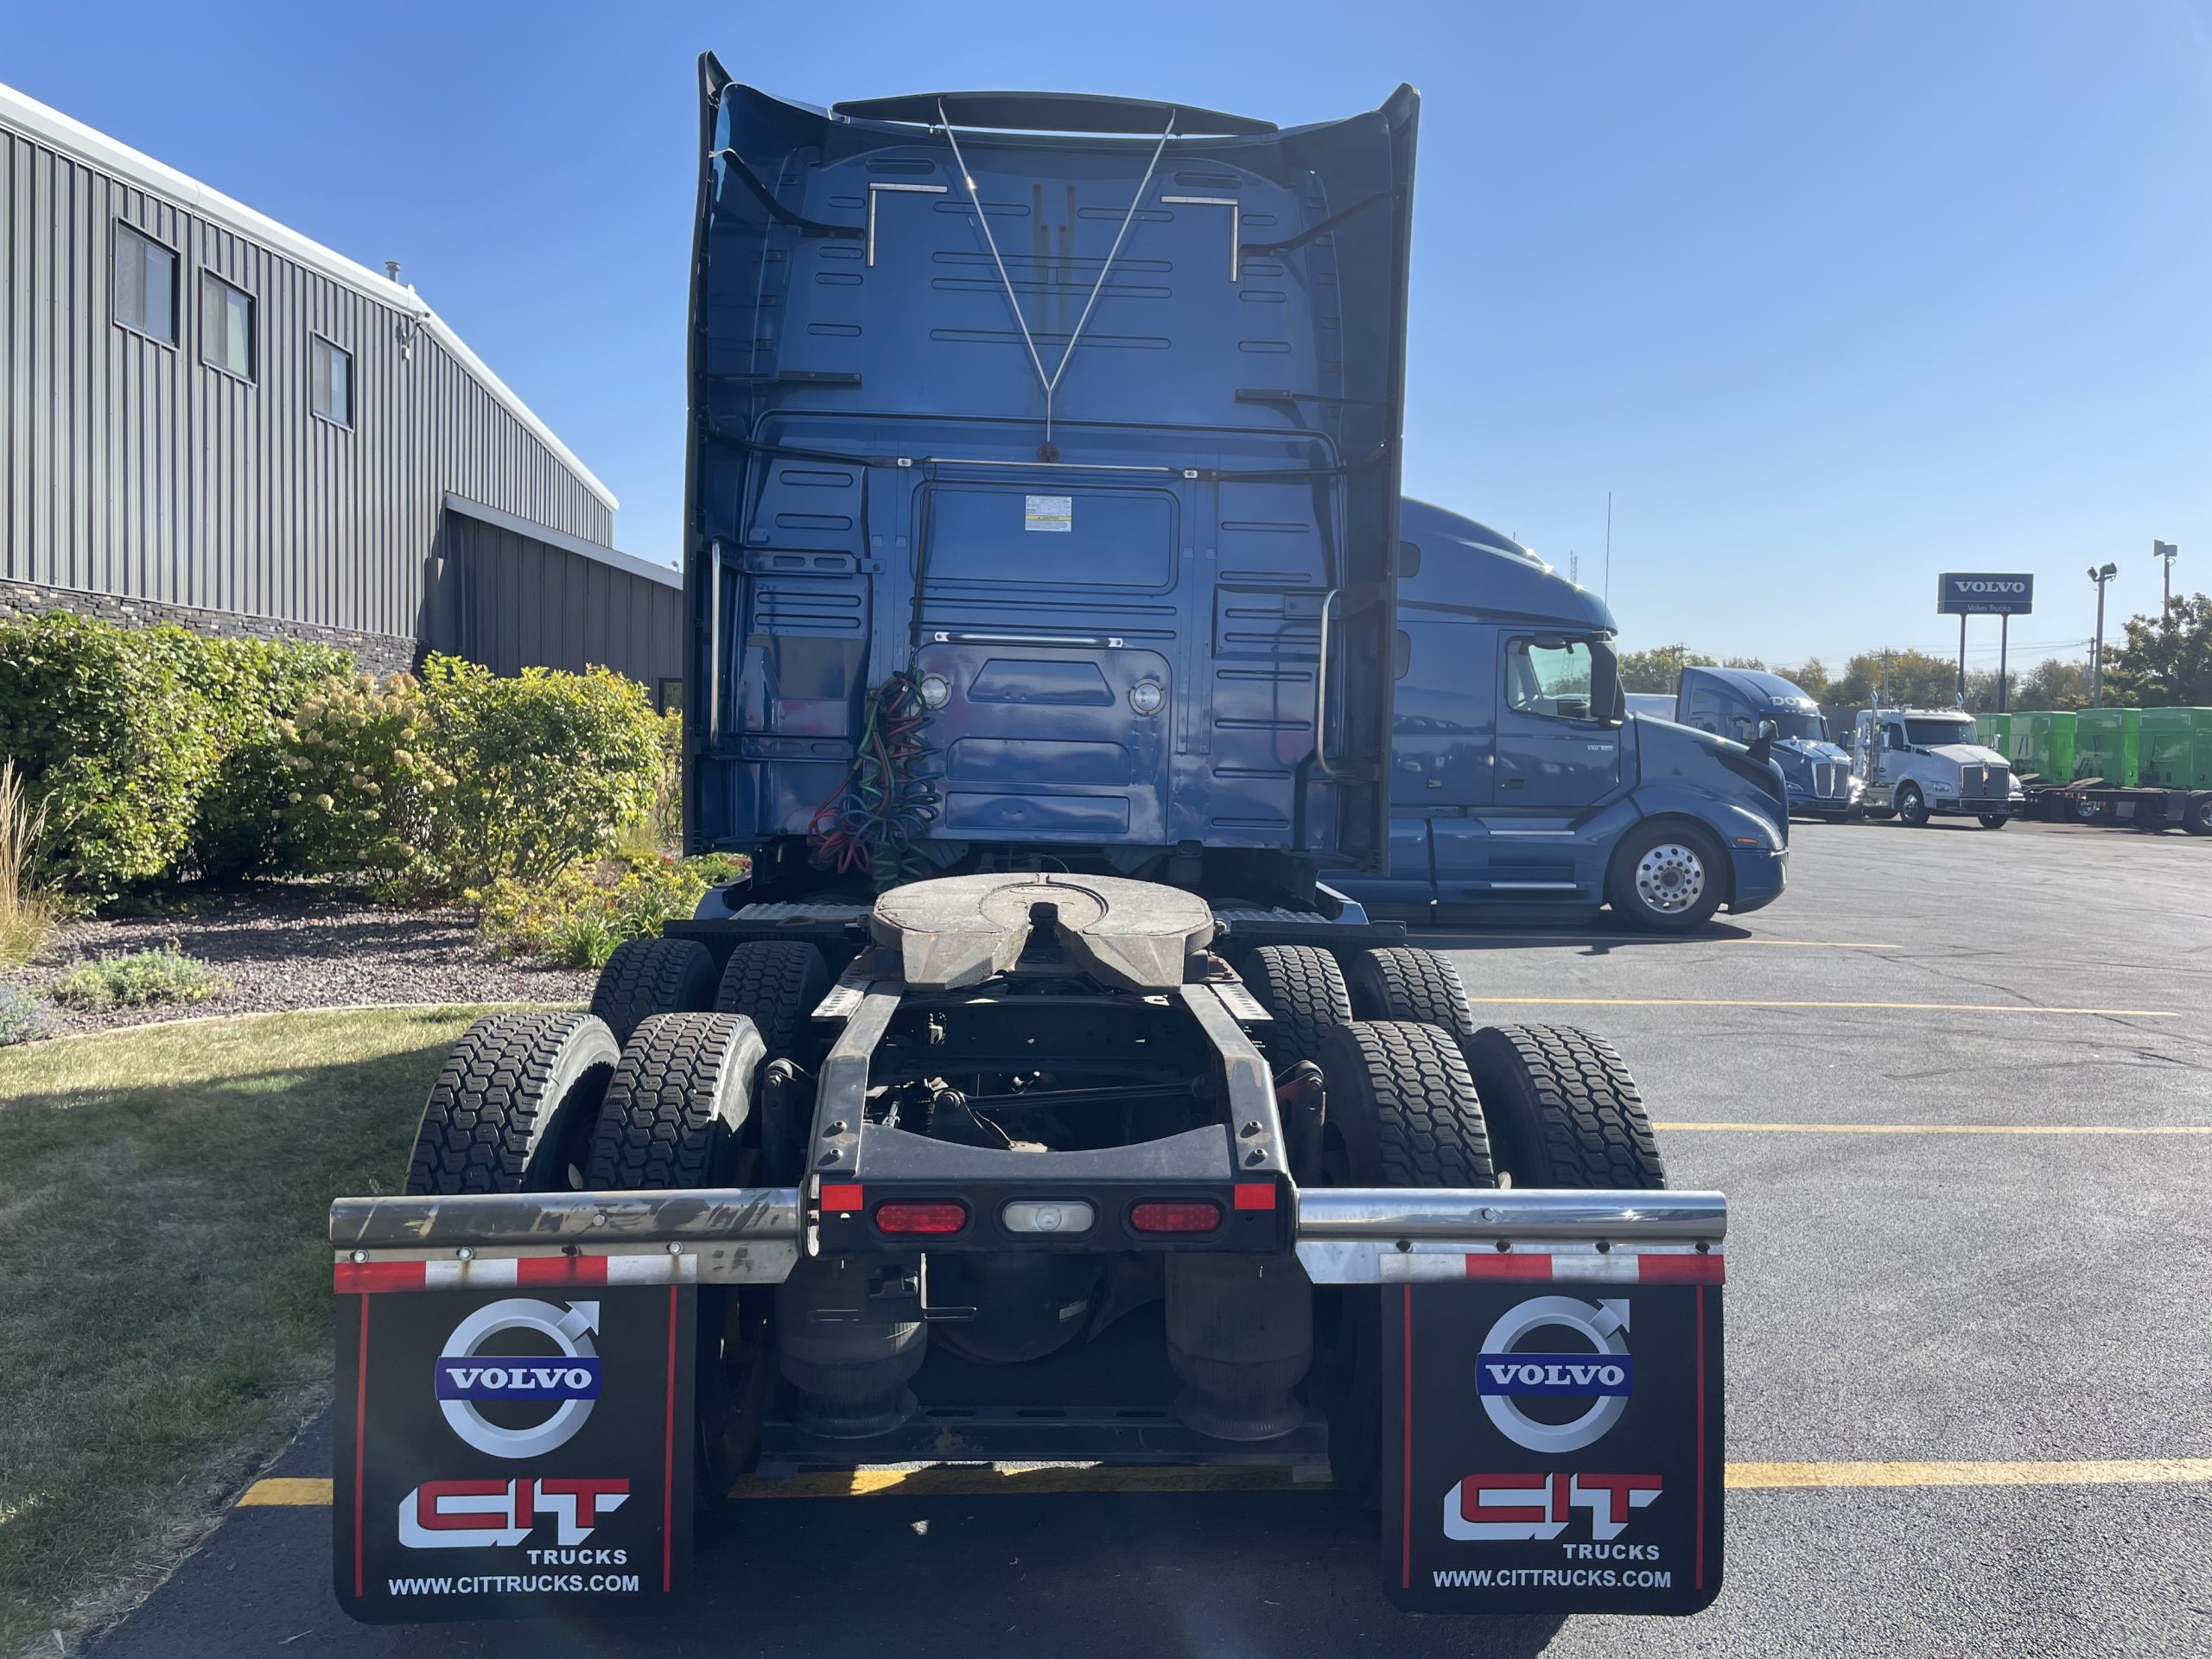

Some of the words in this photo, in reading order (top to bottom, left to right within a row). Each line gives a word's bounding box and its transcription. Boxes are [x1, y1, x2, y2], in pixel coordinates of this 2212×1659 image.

[1955, 581, 2025, 593] VOLVO
[446, 1368, 591, 1389] VOLVO
[1485, 1364, 1624, 1385] VOLVO
[399, 1478, 630, 1548] CIT
[1443, 1472, 1662, 1540] CIT
[527, 1549, 627, 1565] TRUCKS
[1563, 1543, 1659, 1560] TRUCKS
[389, 1574, 639, 1596] WWW.CITTRUCKS.COM
[1433, 1569, 1671, 1588] WWW.CITTRUCKS.COM
